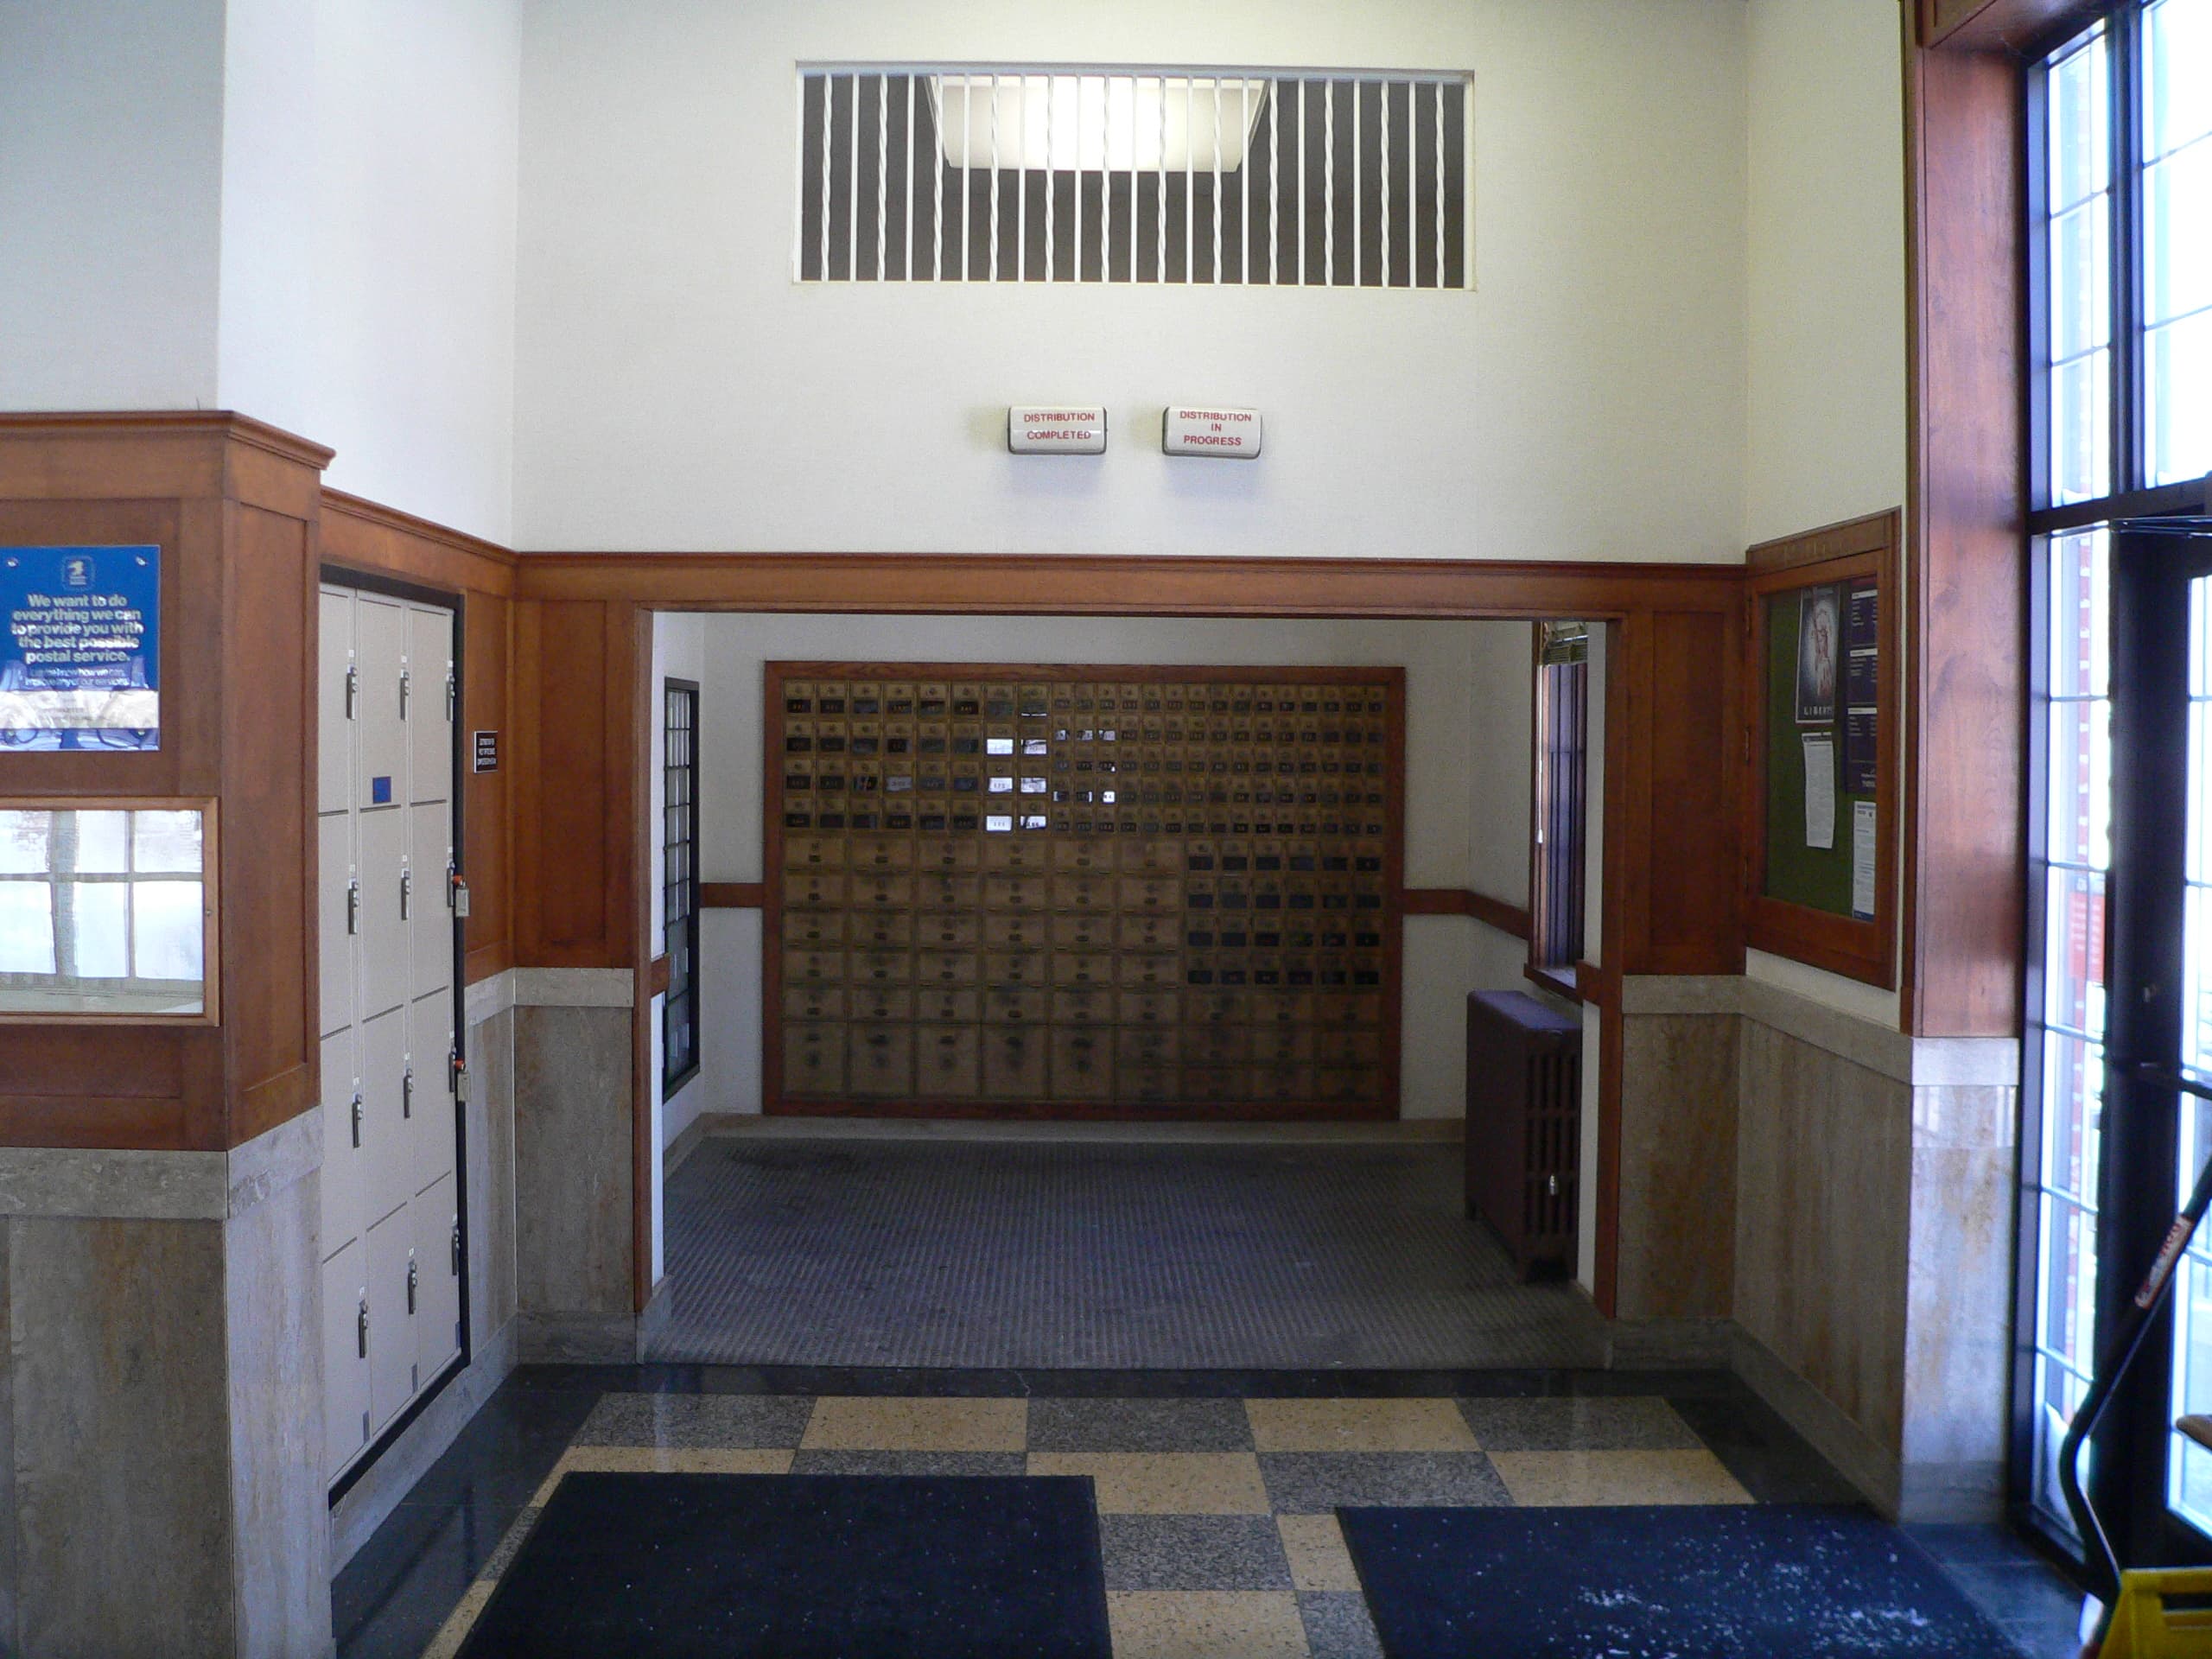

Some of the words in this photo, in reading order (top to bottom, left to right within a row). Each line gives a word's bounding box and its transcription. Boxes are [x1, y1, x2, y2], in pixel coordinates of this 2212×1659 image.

[1024, 412, 1096, 423] DISTRIBUTION
[1179, 410, 1252, 423] DISTRIBUTION
[1211, 423, 1223, 433] IN
[1027, 430, 1091, 441] COMPLETED
[1183, 435, 1243, 447] PROGRESS
[28, 594, 51, 607] We
[53, 594, 89, 607] want
[92, 594, 106, 607] to
[109, 594, 127, 607] do
[13, 608, 90, 623] everything
[92, 610, 113, 620] we
[115, 610, 142, 620] can
[11, 622, 27, 635] to
[28, 622, 82, 637] provide
[83, 624, 109, 636] you
[111, 621, 144, 634] with
[19, 637, 41, 648] the
[44, 636, 77, 648] best
[79, 635, 140, 651] possible
[25, 650, 71, 664] postal
[73, 650, 130, 662] service.
